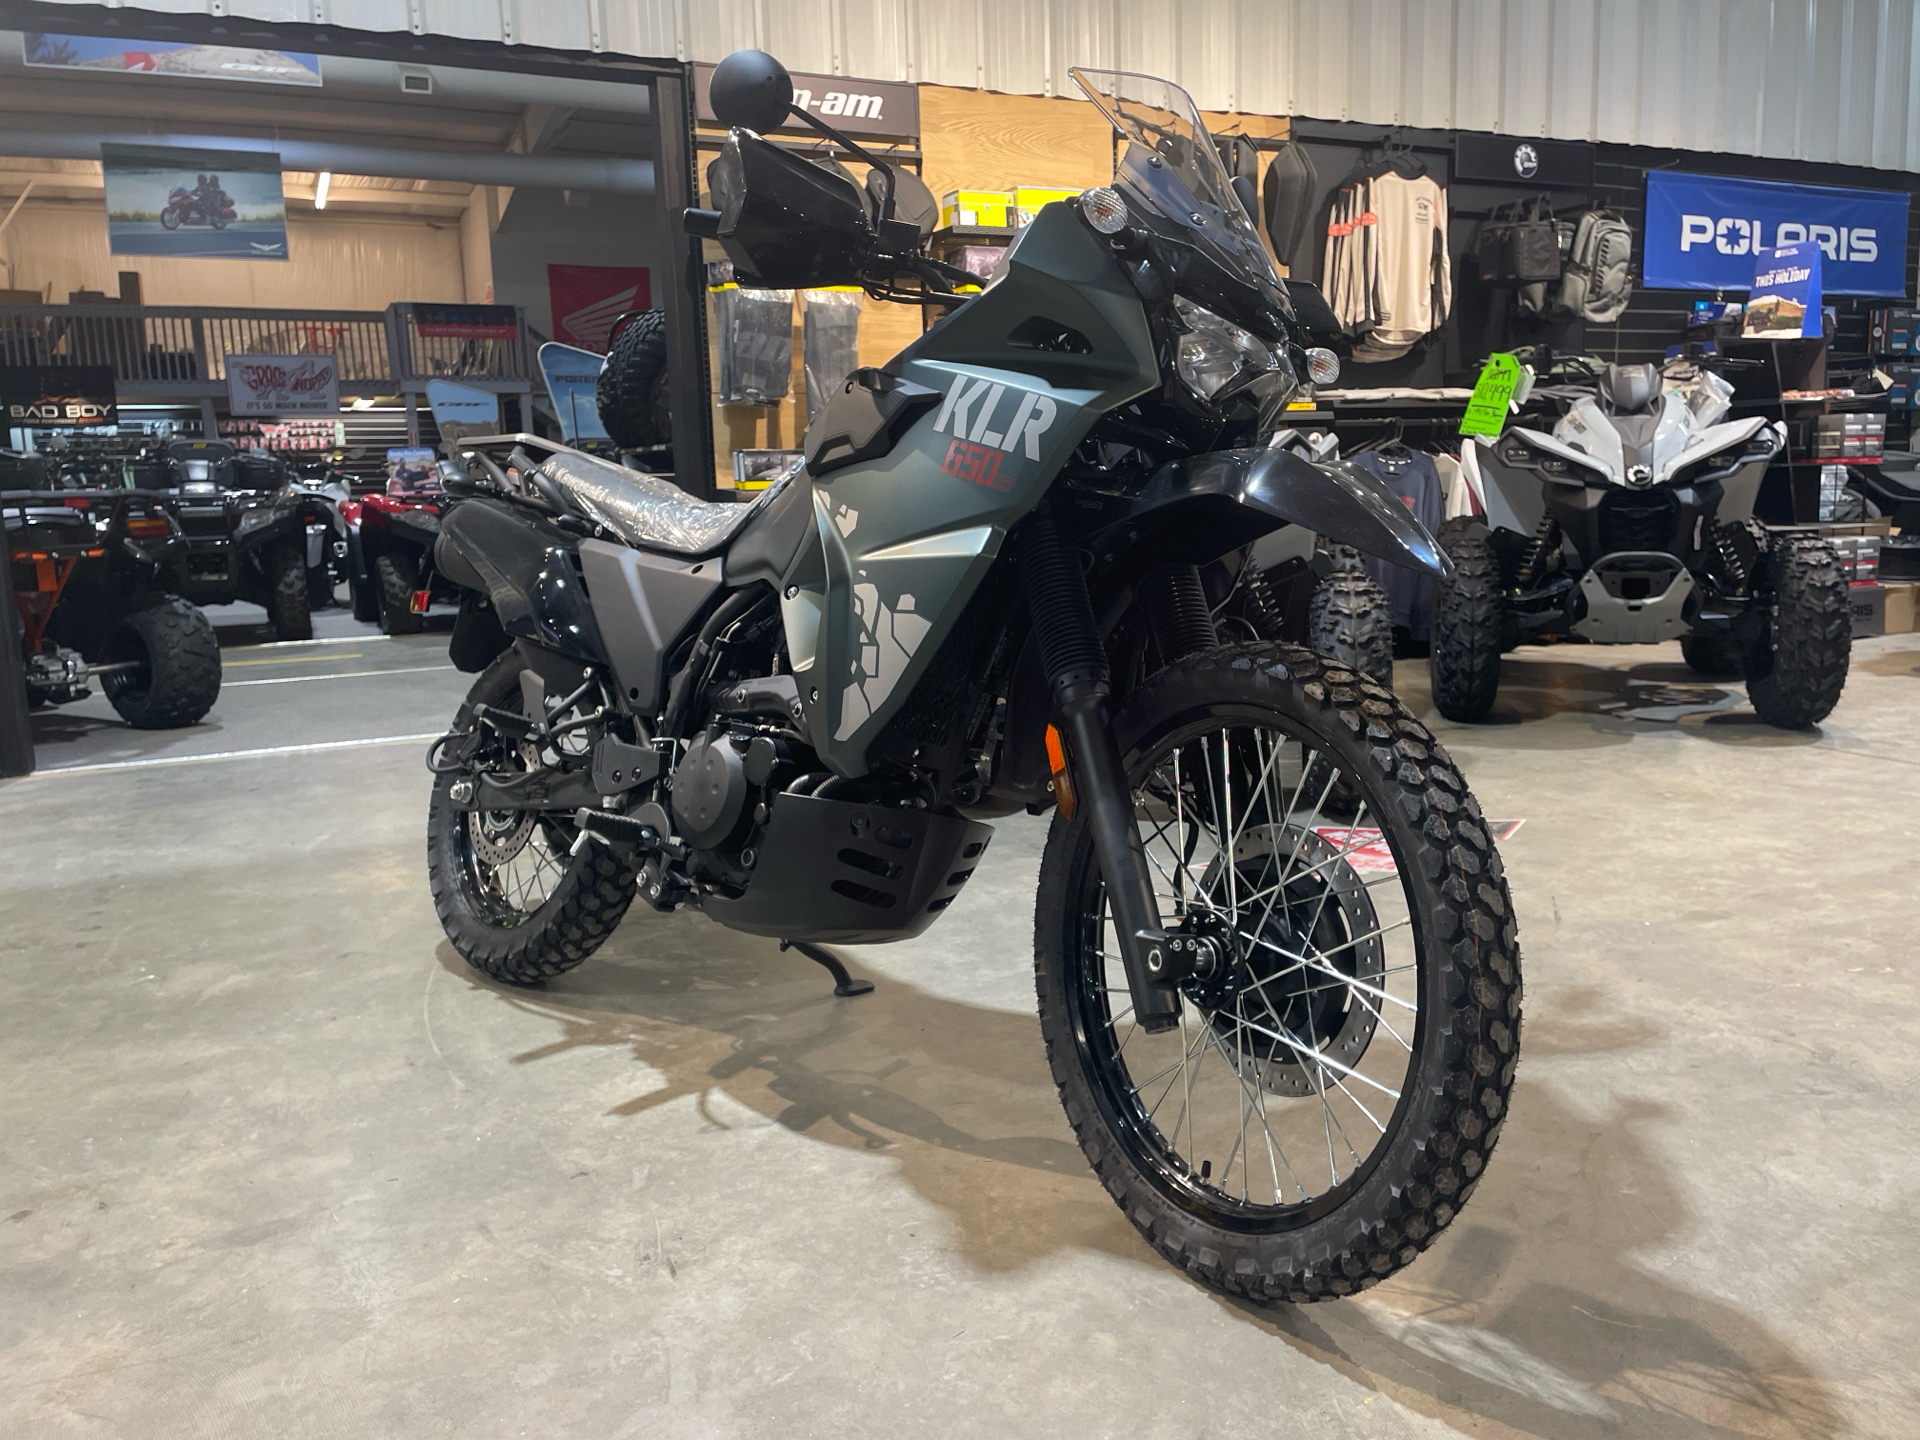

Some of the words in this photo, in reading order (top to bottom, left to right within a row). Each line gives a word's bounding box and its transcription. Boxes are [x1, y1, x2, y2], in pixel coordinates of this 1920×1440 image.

[793, 88, 884, 120] n-am
[1681, 214, 1878, 262] POLARIS
[1755, 274, 1775, 288] THIS
[1775, 268, 1810, 285] HOLIDAY
[10, 404, 58, 418] BAD
[65, 403, 112, 418] BOY
[932, 373, 1057, 462] KLR
[554, 467, 610, 502] Kawasaki
[1074, 498, 1104, 511] ABS
